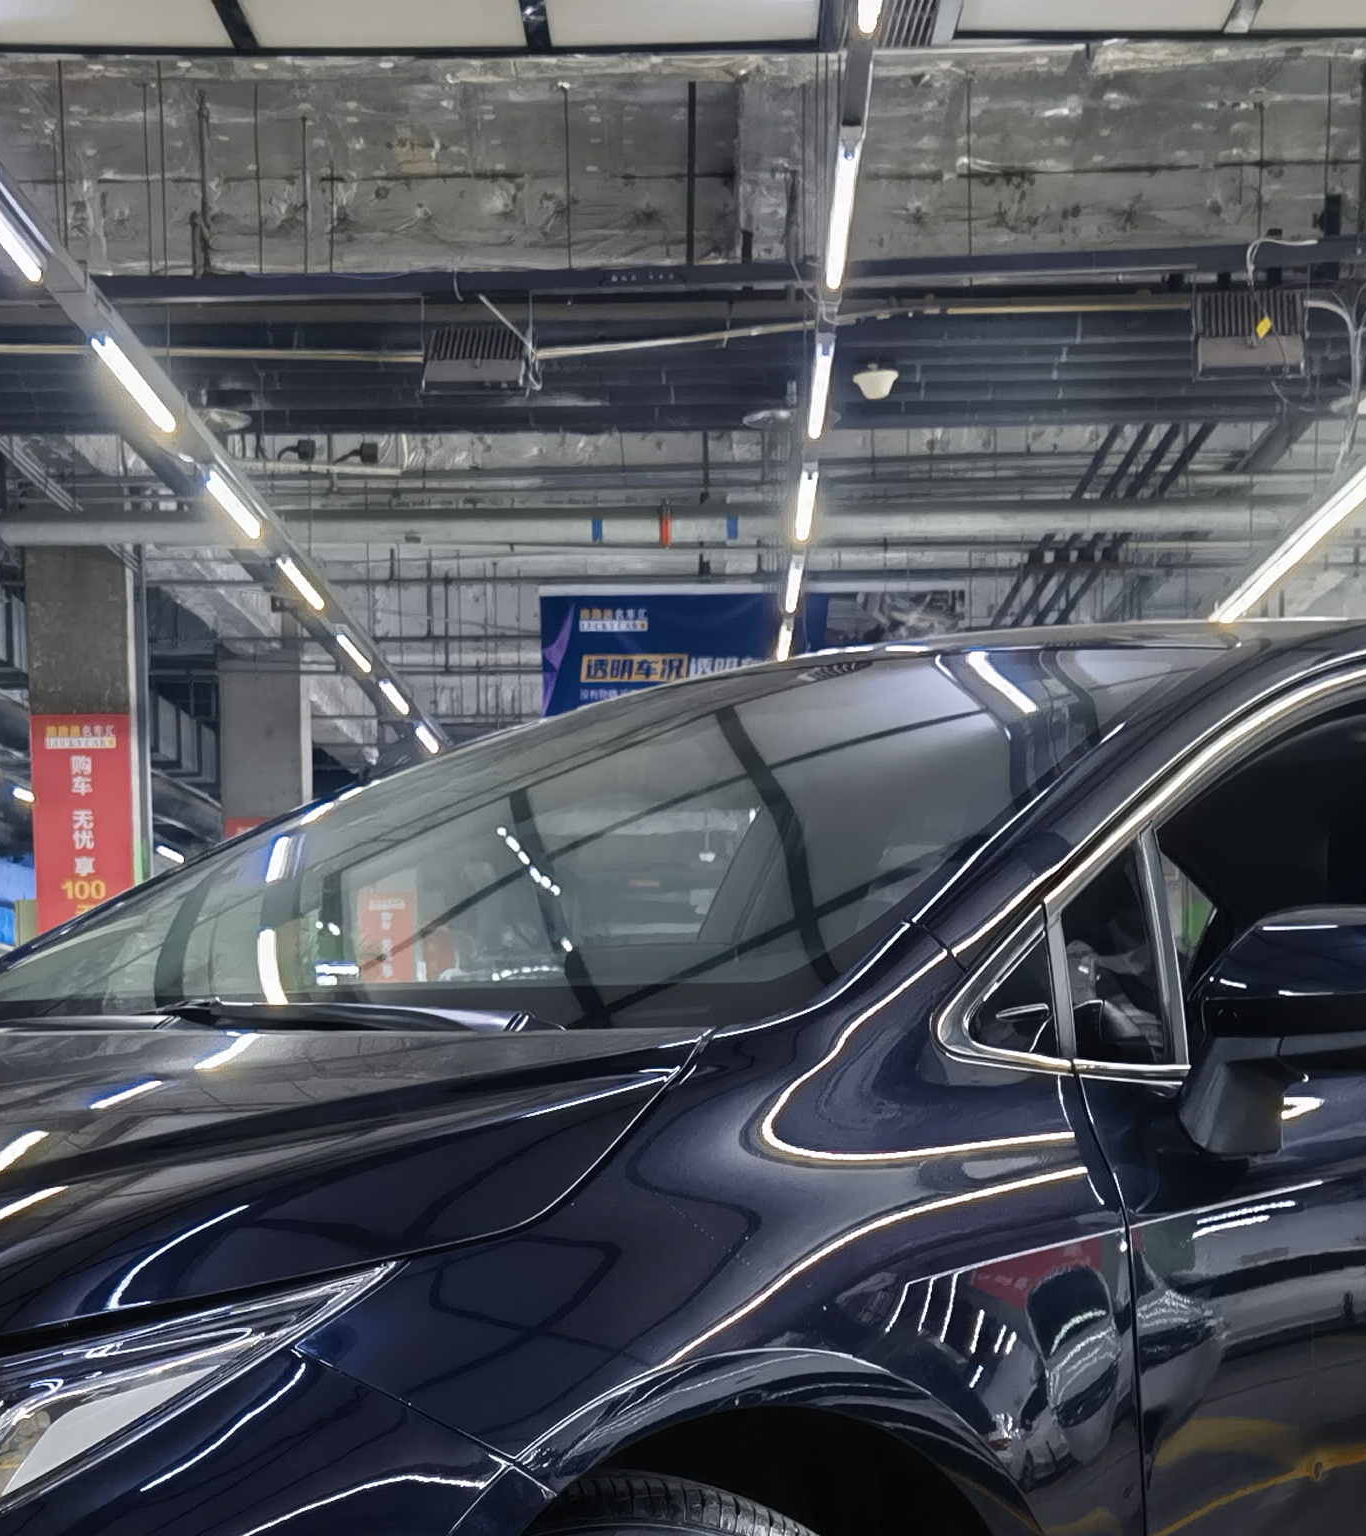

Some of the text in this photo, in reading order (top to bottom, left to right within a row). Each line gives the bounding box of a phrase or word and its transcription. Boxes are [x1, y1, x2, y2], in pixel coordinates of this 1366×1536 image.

[585, 658, 685, 680] 透明车况
[69, 755, 93, 796] 购车
[71, 809, 94, 850] 无忧
[61, 879, 107, 900] 100
